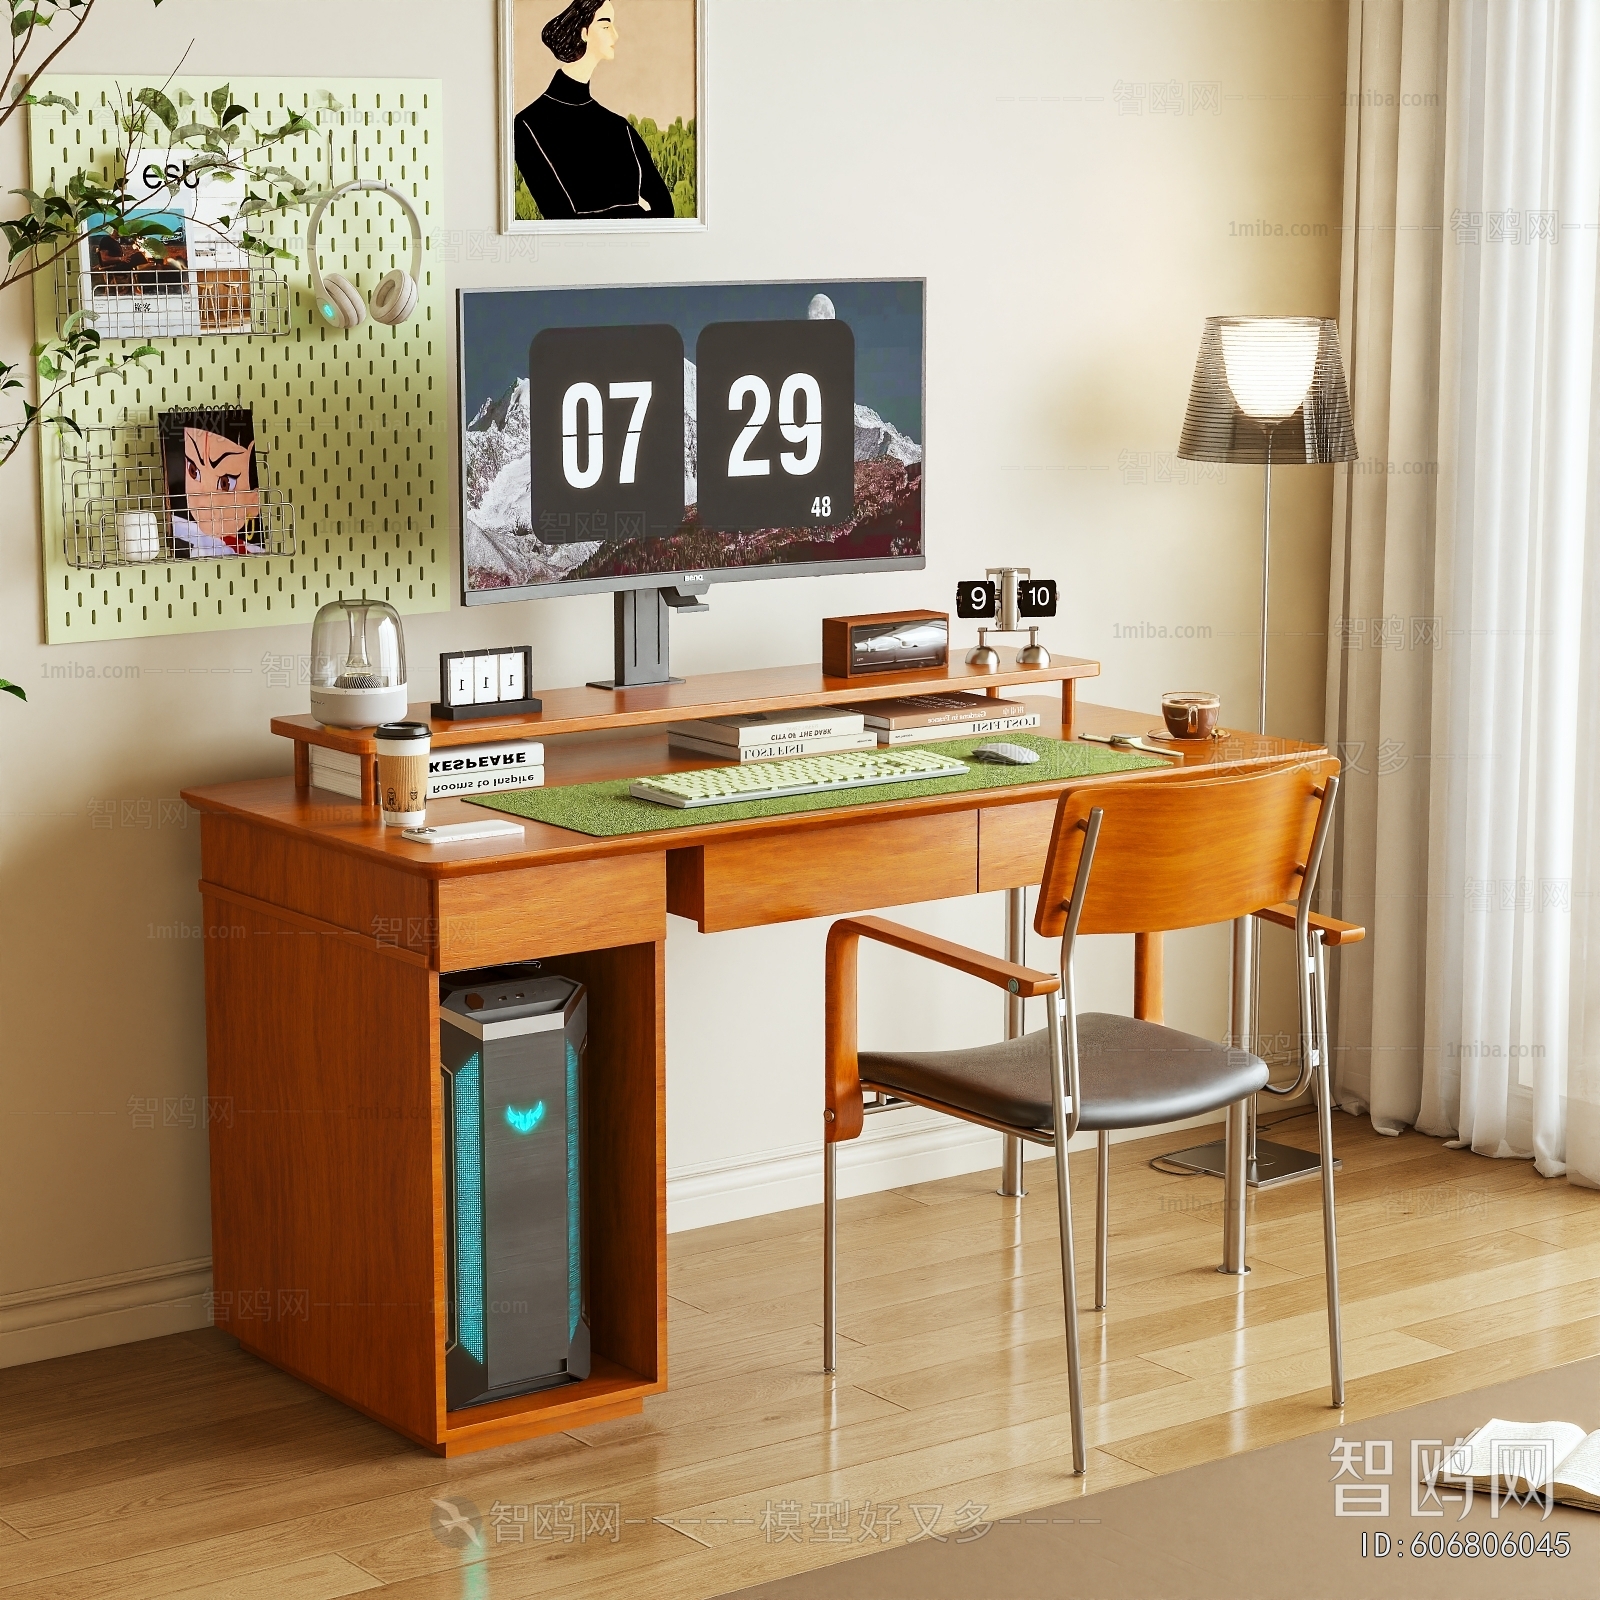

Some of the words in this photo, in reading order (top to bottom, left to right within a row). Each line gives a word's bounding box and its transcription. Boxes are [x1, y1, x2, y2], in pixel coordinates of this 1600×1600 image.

[562, 380, 653, 490] 07
[727, 372, 823, 478] 29
[810, 496, 832, 518] 48
[970, 586, 987, 610] 9
[1028, 586, 1050, 606] 10
